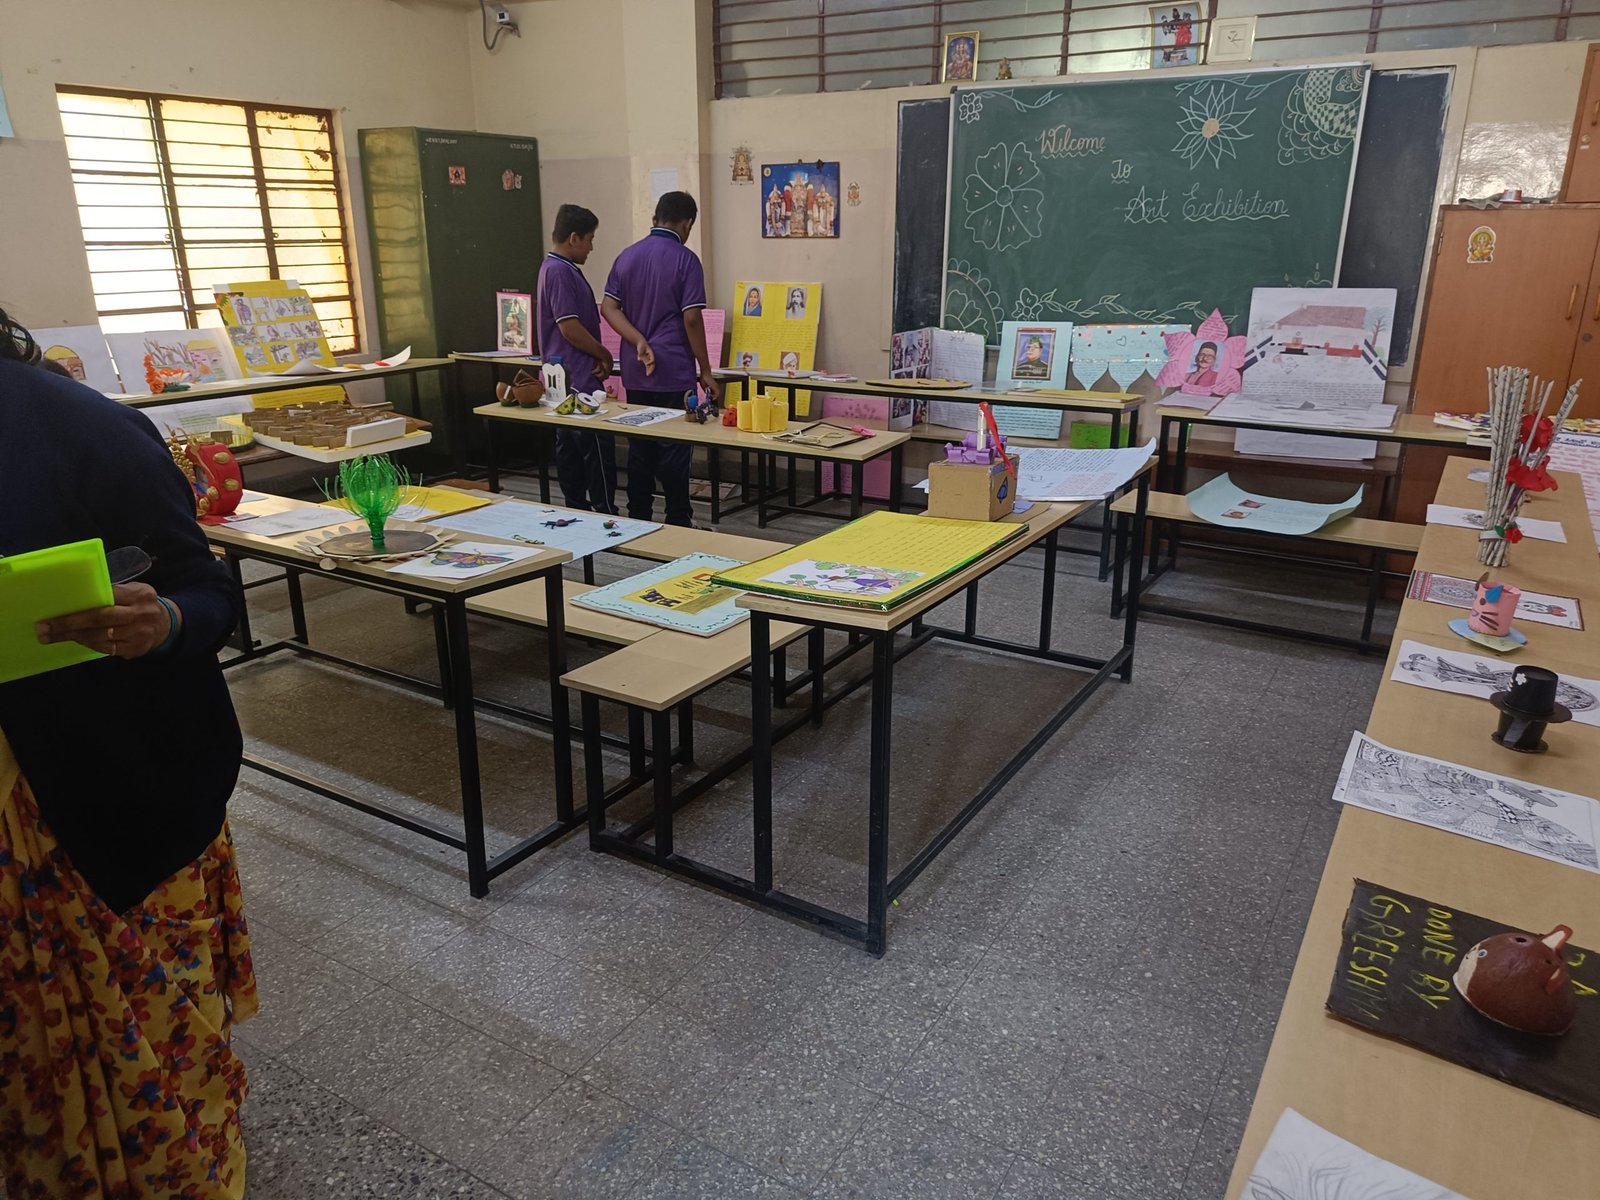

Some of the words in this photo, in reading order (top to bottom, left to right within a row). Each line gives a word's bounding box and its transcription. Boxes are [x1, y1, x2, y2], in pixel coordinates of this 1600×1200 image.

[1111, 159, 1133, 179] To
[1124, 185, 1169, 219] Art
[1182, 182, 1289, 218] Exhibition
[1422, 906, 1456, 966] DONE
[1402, 970, 1450, 1010] BY
